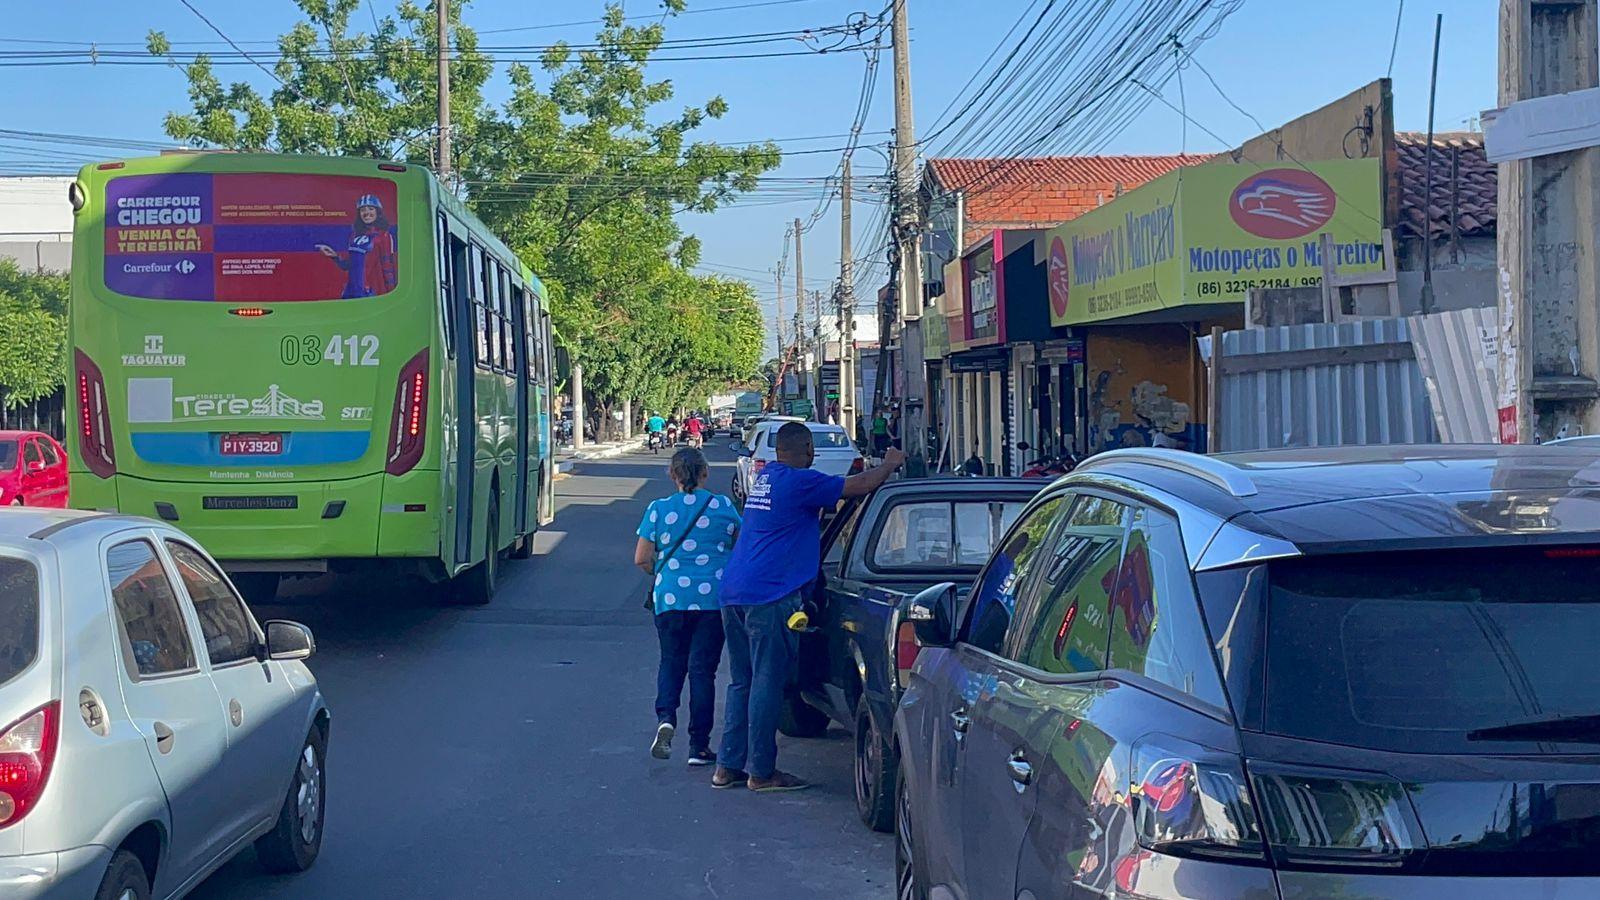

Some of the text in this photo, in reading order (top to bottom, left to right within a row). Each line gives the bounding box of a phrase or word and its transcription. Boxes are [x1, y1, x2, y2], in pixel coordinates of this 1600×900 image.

[117, 196, 200, 208] CARREFOUR
[118, 208, 201, 225] CHEGOU
[118, 229, 172, 241] VENHA
[1189, 239, 1379, 275] Motopeças o Mreiro
[124, 263, 172, 273] Carrefour
[1197, 281, 1221, 298] (86)
[281, 334, 380, 365] 03412
[121, 355, 186, 367] TAGUATUR
[174, 386, 324, 417] Teresina
[209, 471, 250, 479] Mantenha
[207, 497, 294, 509] Mercedes-Benz
